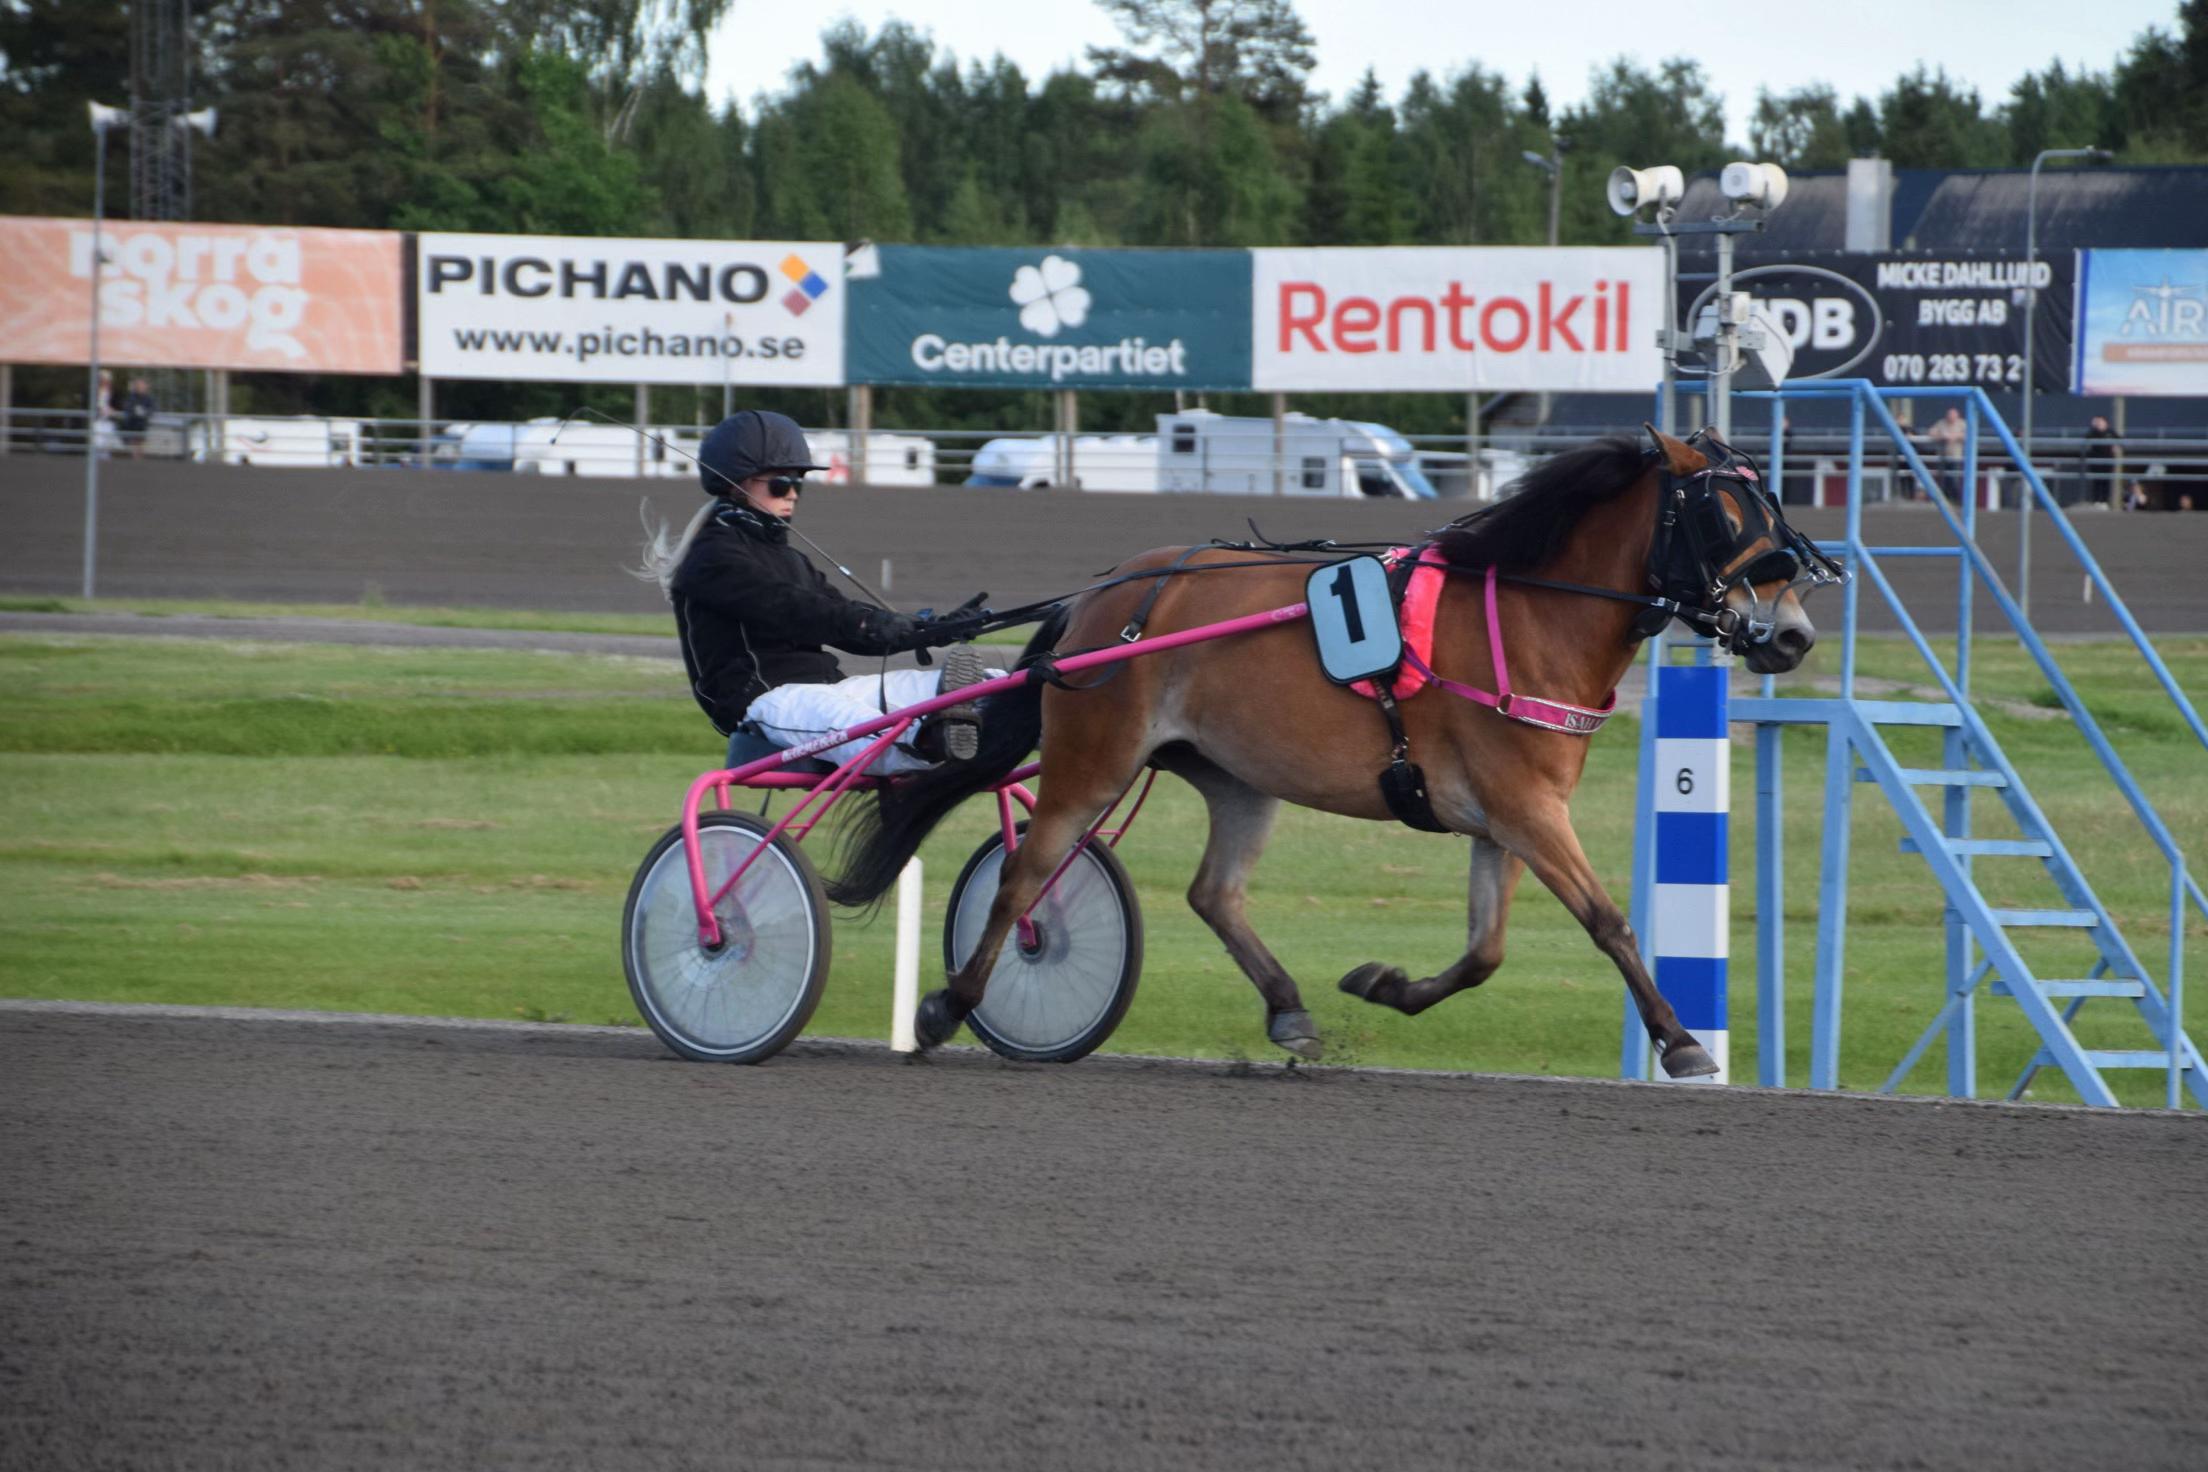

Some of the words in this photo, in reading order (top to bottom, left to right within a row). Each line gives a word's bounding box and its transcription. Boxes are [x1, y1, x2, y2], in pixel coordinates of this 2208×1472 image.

[70, 231, 300, 284] norra
[427, 255, 770, 304] PICHANO
[1877, 262, 1941, 290] MICKE
[99, 278, 309, 358] skog
[1278, 280, 1630, 353] Rentokil
[1714, 298, 1855, 350] DB
[1918, 299, 1976, 326] BYGG
[1977, 298, 2007, 326] AB
[453, 326, 806, 361] www.pichano.se
[911, 333, 1186, 382] Centerpartiet
[1883, 354, 1925, 382] 070
[1928, 354, 1971, 382] 283
[1974, 354, 2004, 382] 73
[1329, 564, 1366, 645] 1
[1676, 767, 1694, 796] 6
